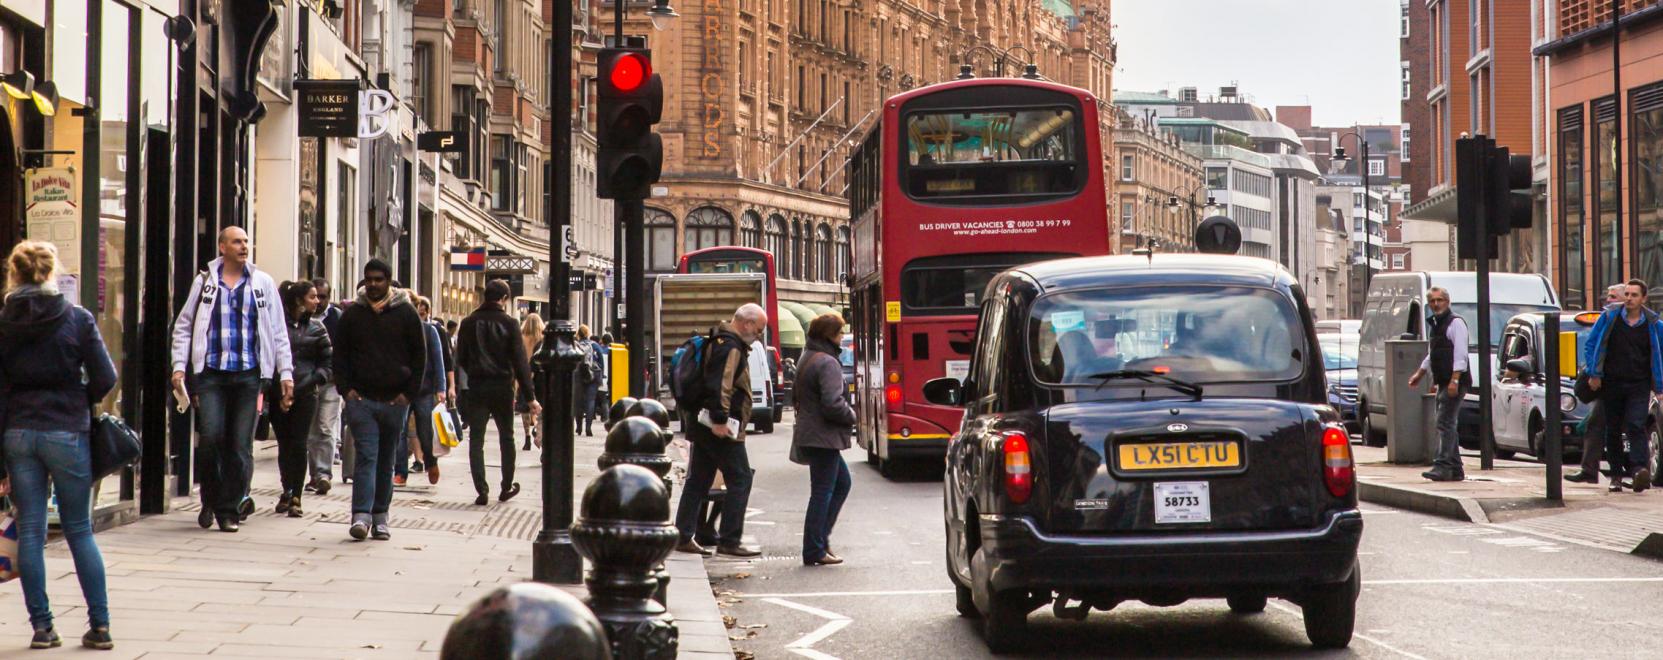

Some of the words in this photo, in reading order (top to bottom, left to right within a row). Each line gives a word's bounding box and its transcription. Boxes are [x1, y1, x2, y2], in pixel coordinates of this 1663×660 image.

[307, 95, 349, 104] BARKER
[32, 180, 41, 192] La
[41, 176, 58, 187] Dolce
[59, 176, 71, 190] Vita
[33, 194, 68, 202] Restaurant
[920, 223, 934, 231] BUS
[935, 222, 961, 230] DRIVER
[962, 221, 1004, 229] VACANCIES
[1017, 220, 1034, 228] 0800
[1133, 445, 1182, 465] LX51
[1187, 442, 1231, 463] CTU
[1165, 496, 1199, 507] 58733
